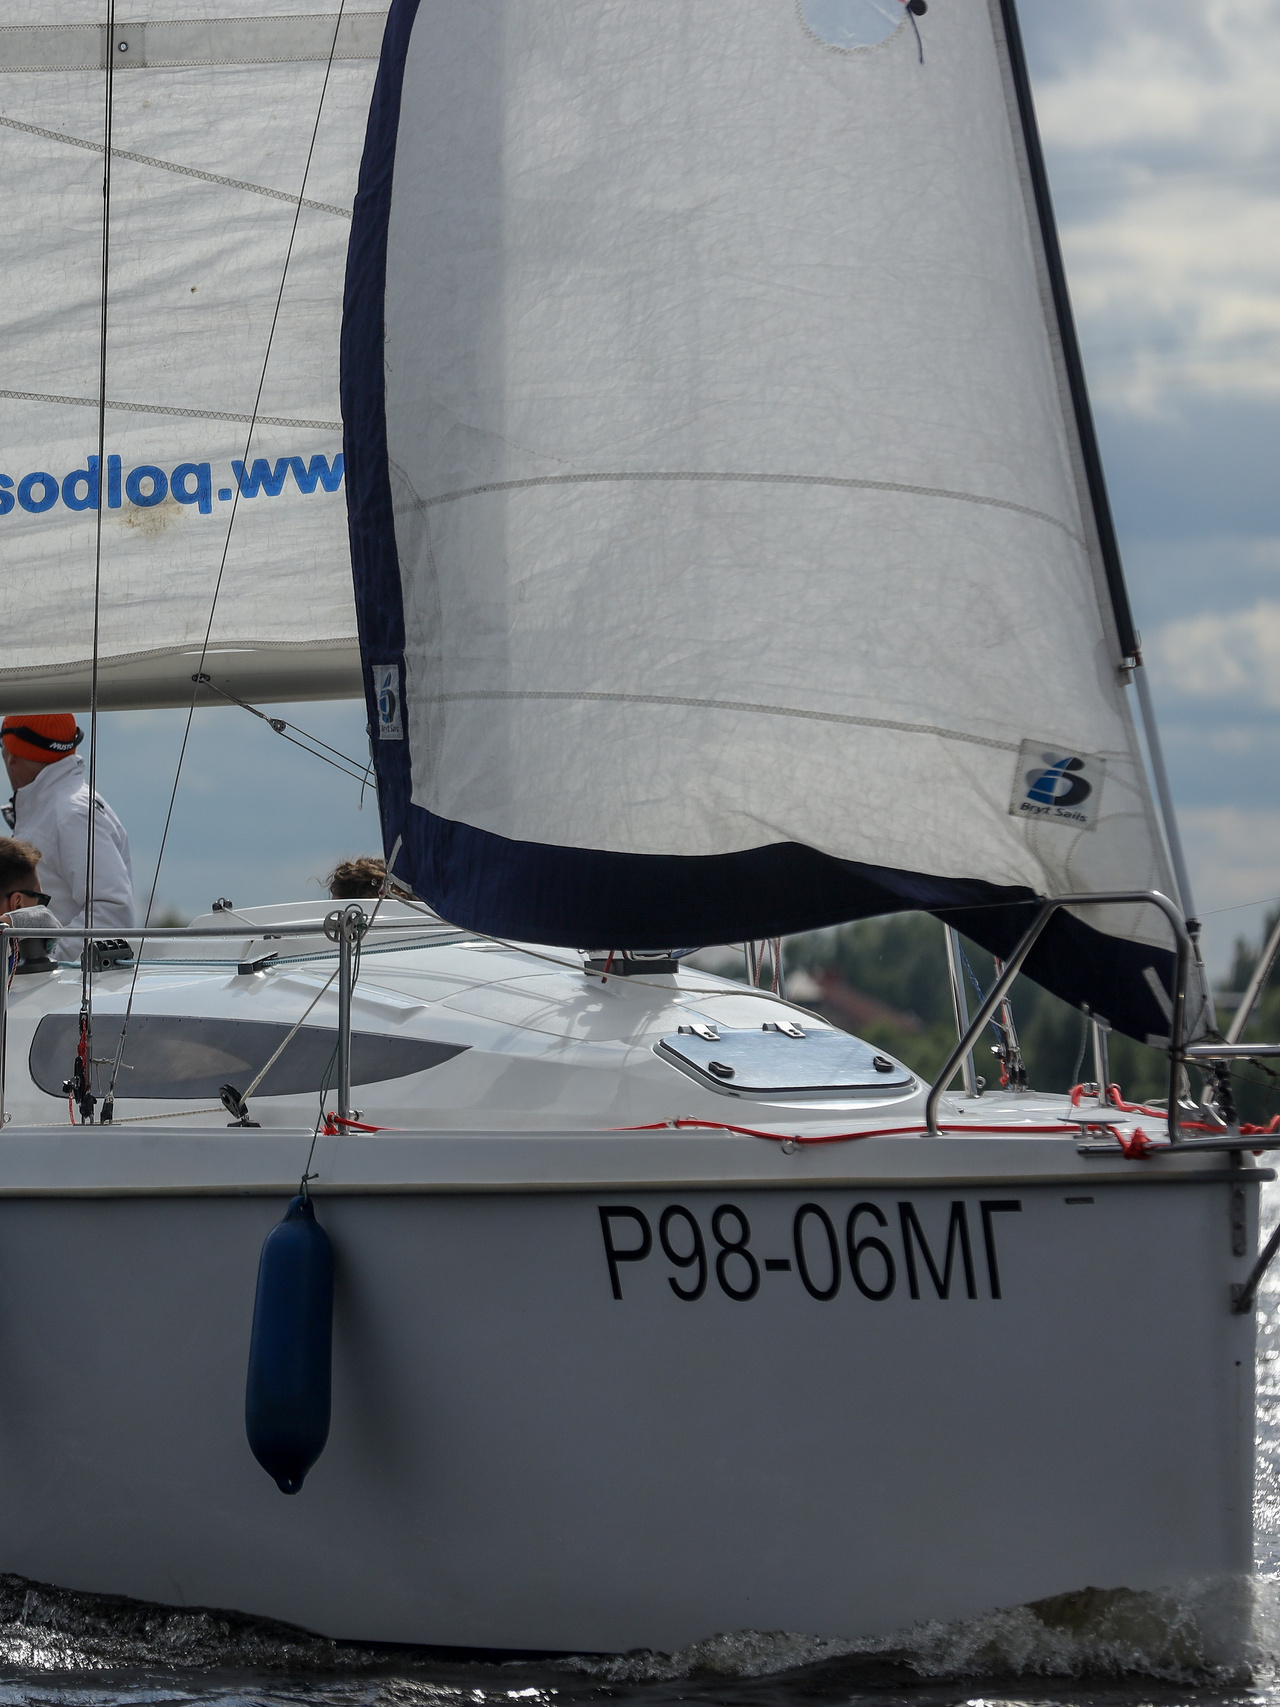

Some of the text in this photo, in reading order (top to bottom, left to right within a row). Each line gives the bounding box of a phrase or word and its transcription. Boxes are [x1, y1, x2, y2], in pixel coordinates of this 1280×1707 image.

[1020, 802, 1088, 822] Bryt Sails
[598, 1199, 1022, 1302] Р98-06МГ
